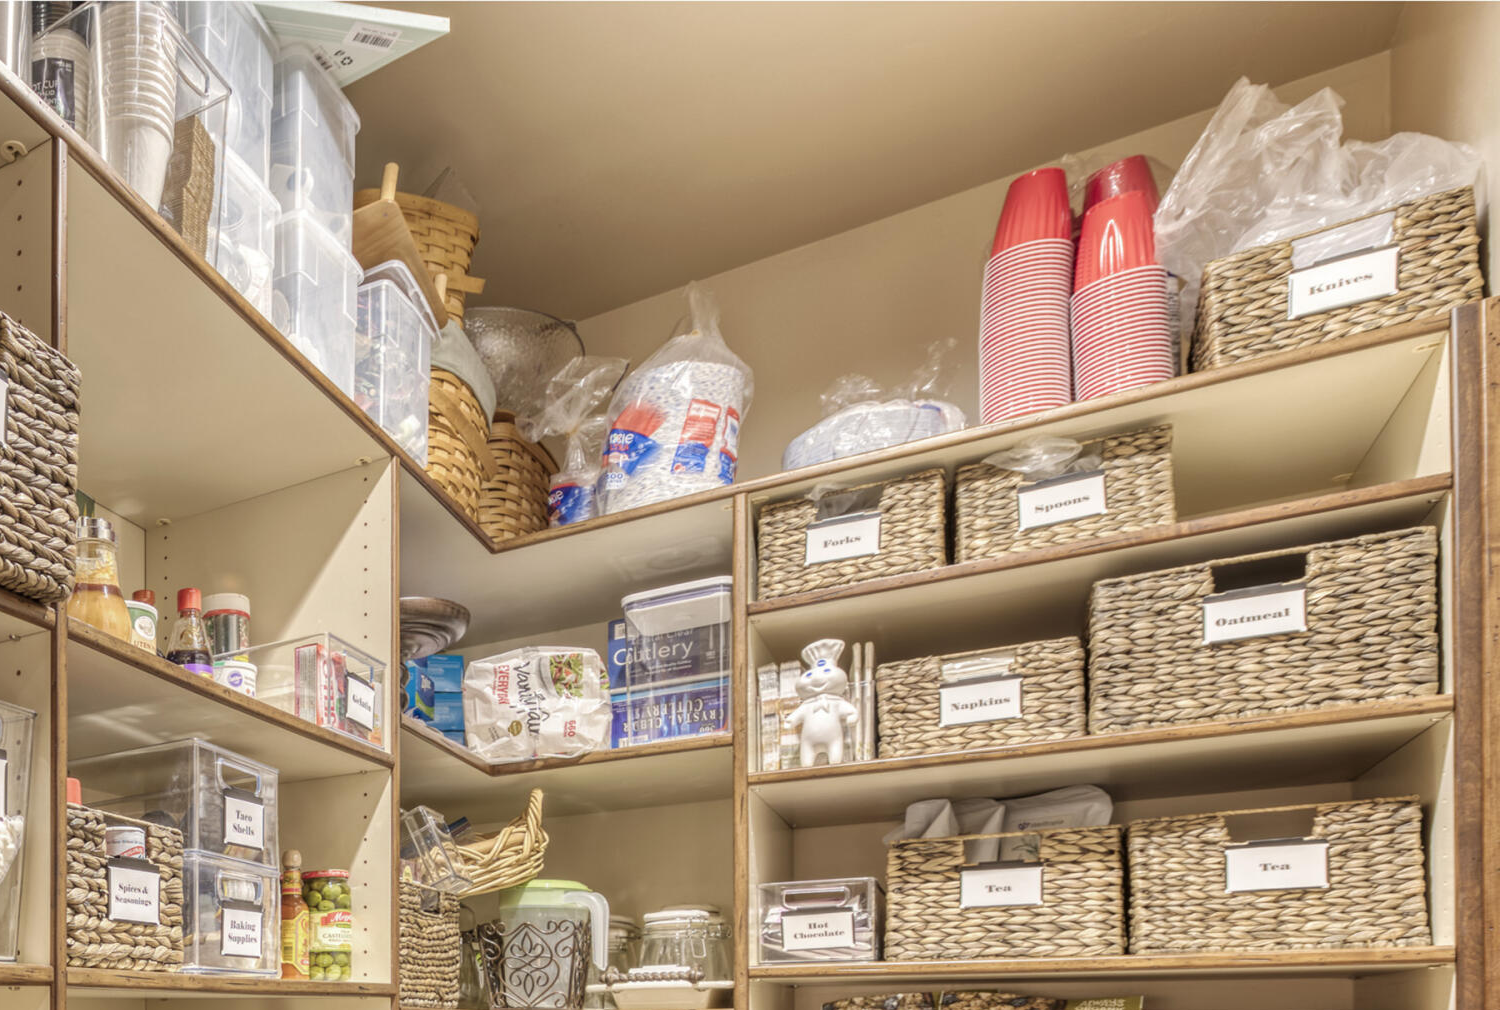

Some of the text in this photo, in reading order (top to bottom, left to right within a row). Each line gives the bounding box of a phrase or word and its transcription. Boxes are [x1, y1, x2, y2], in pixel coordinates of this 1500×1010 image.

[1307, 269, 1374, 296] Knives
[1034, 493, 1091, 514] Spoons
[822, 534, 862, 549] Forks
[1214, 607, 1291, 628] Oatmeal
[613, 641, 694, 666] Cutlery
[950, 694, 1012, 714] Napkins
[235, 809, 253, 823] Taco
[232, 823, 255, 837] Shells
[1259, 859, 1292, 874] Tea
[118, 883, 149, 895] Spices &
[984, 881, 1013, 896] Tea
[114, 893, 152, 907] Seasonings
[230, 919, 256, 933] Baking
[808, 922, 829, 930] Hot
[228, 932, 258, 946] Supplies
[793, 930, 845, 940] Chocolate
